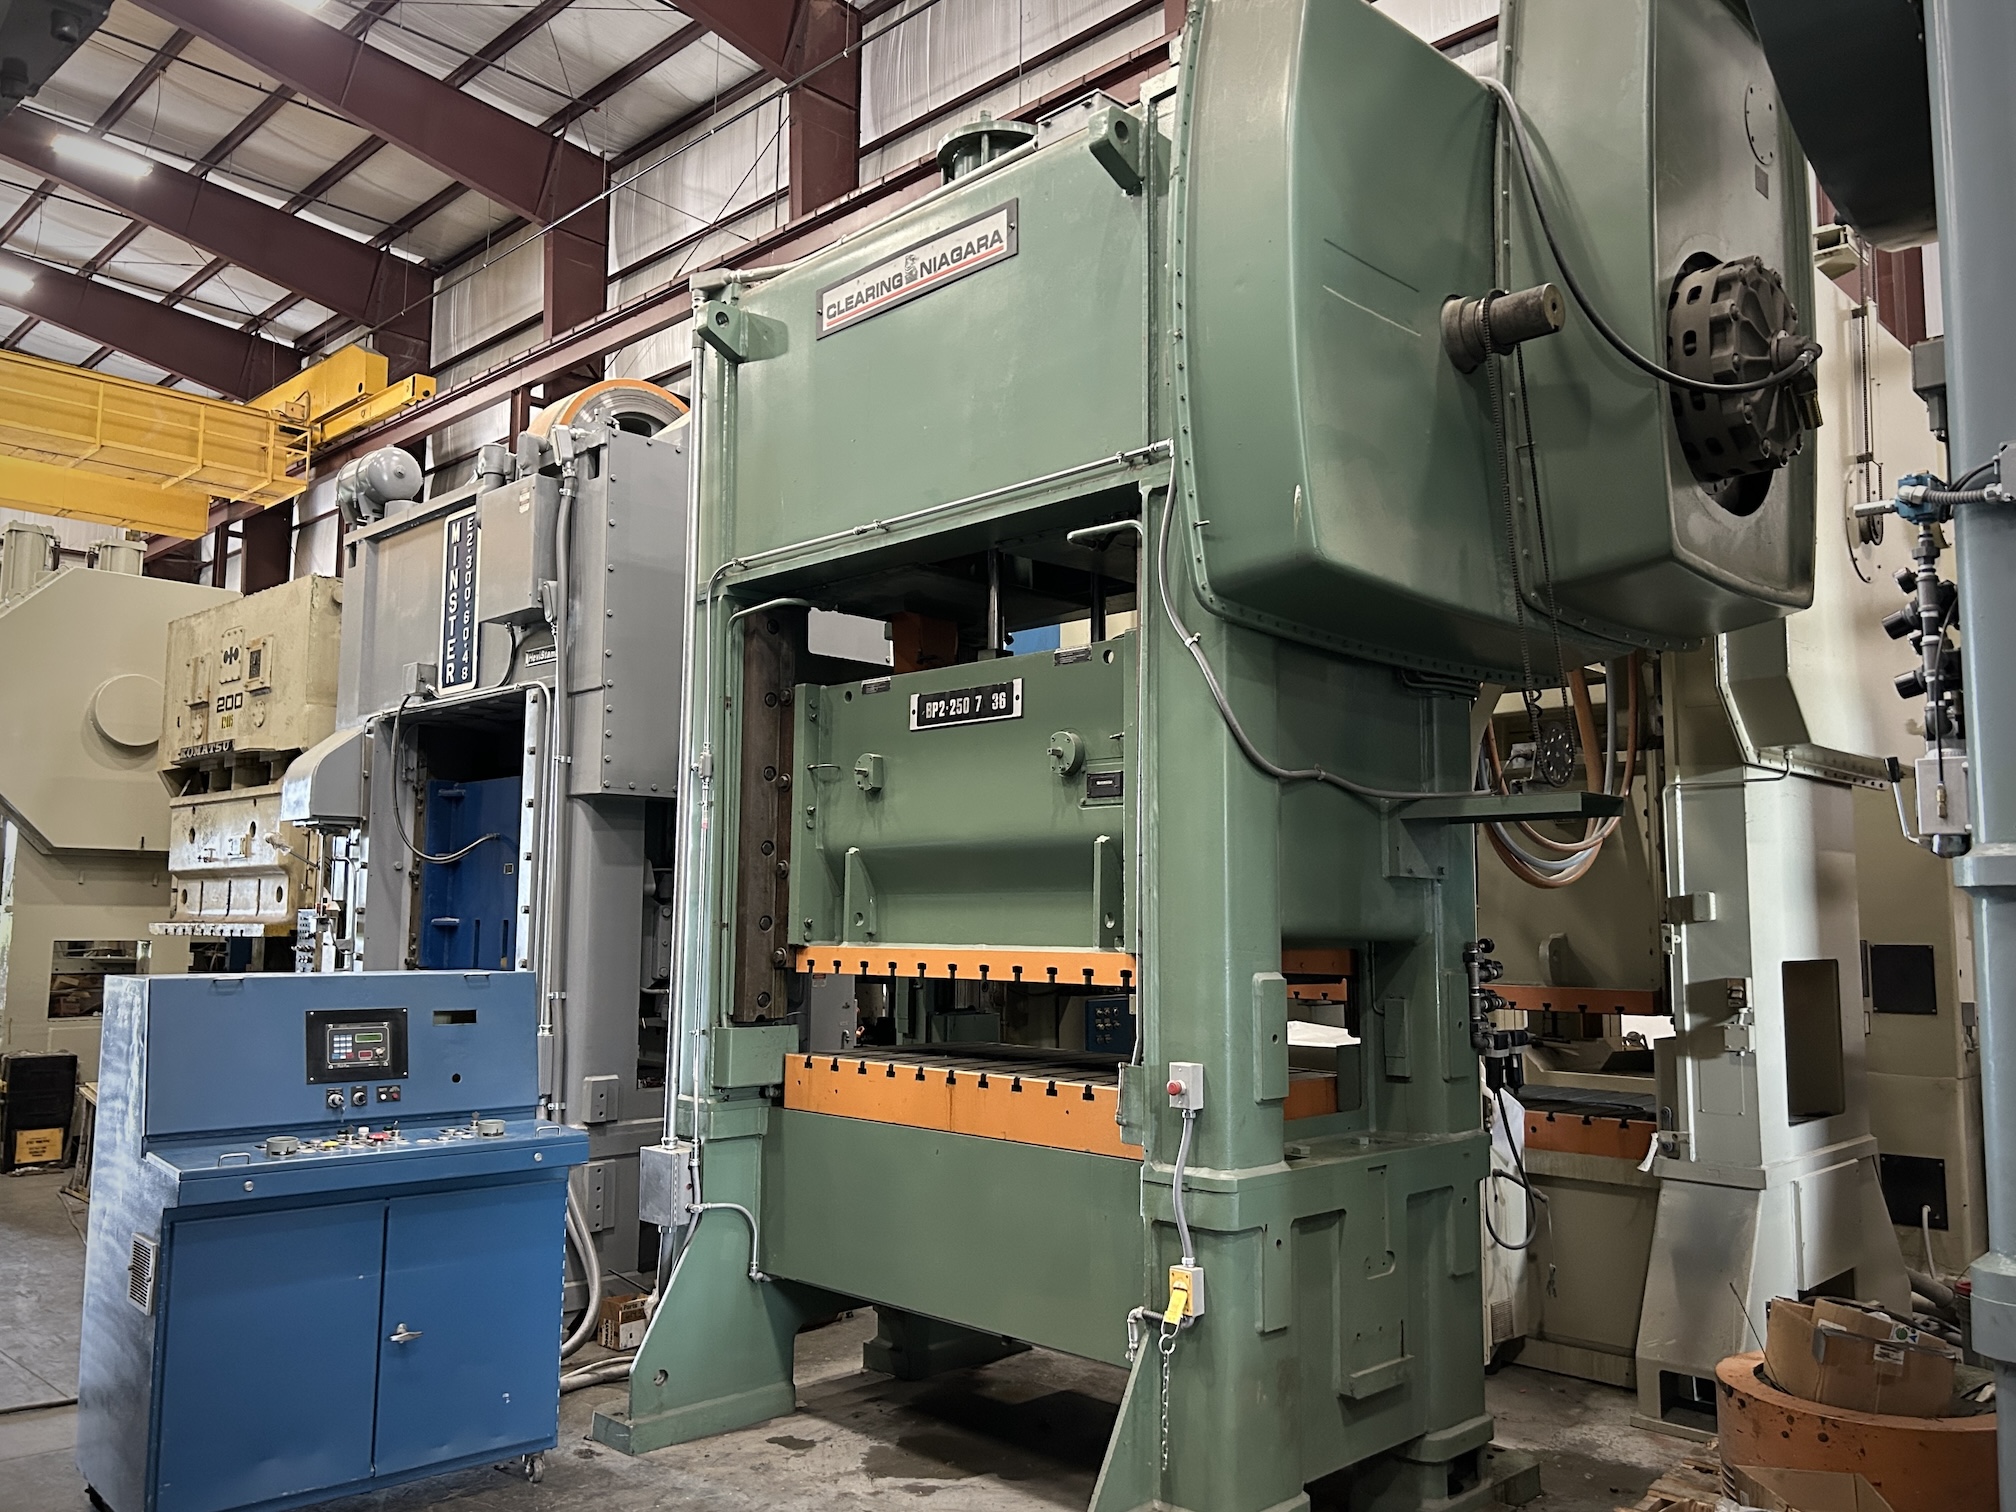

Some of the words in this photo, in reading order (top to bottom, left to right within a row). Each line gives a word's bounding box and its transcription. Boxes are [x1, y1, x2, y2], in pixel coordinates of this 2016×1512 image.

[826, 272, 904, 320] CLEARING
[919, 229, 1004, 278] NIAGARA
[445, 521, 461, 684] MINSTER
[216, 692, 243, 713] 200
[975, 695, 982, 712] 7
[991, 692, 1007, 710] 36
[180, 740, 230, 758] KOMATSU
